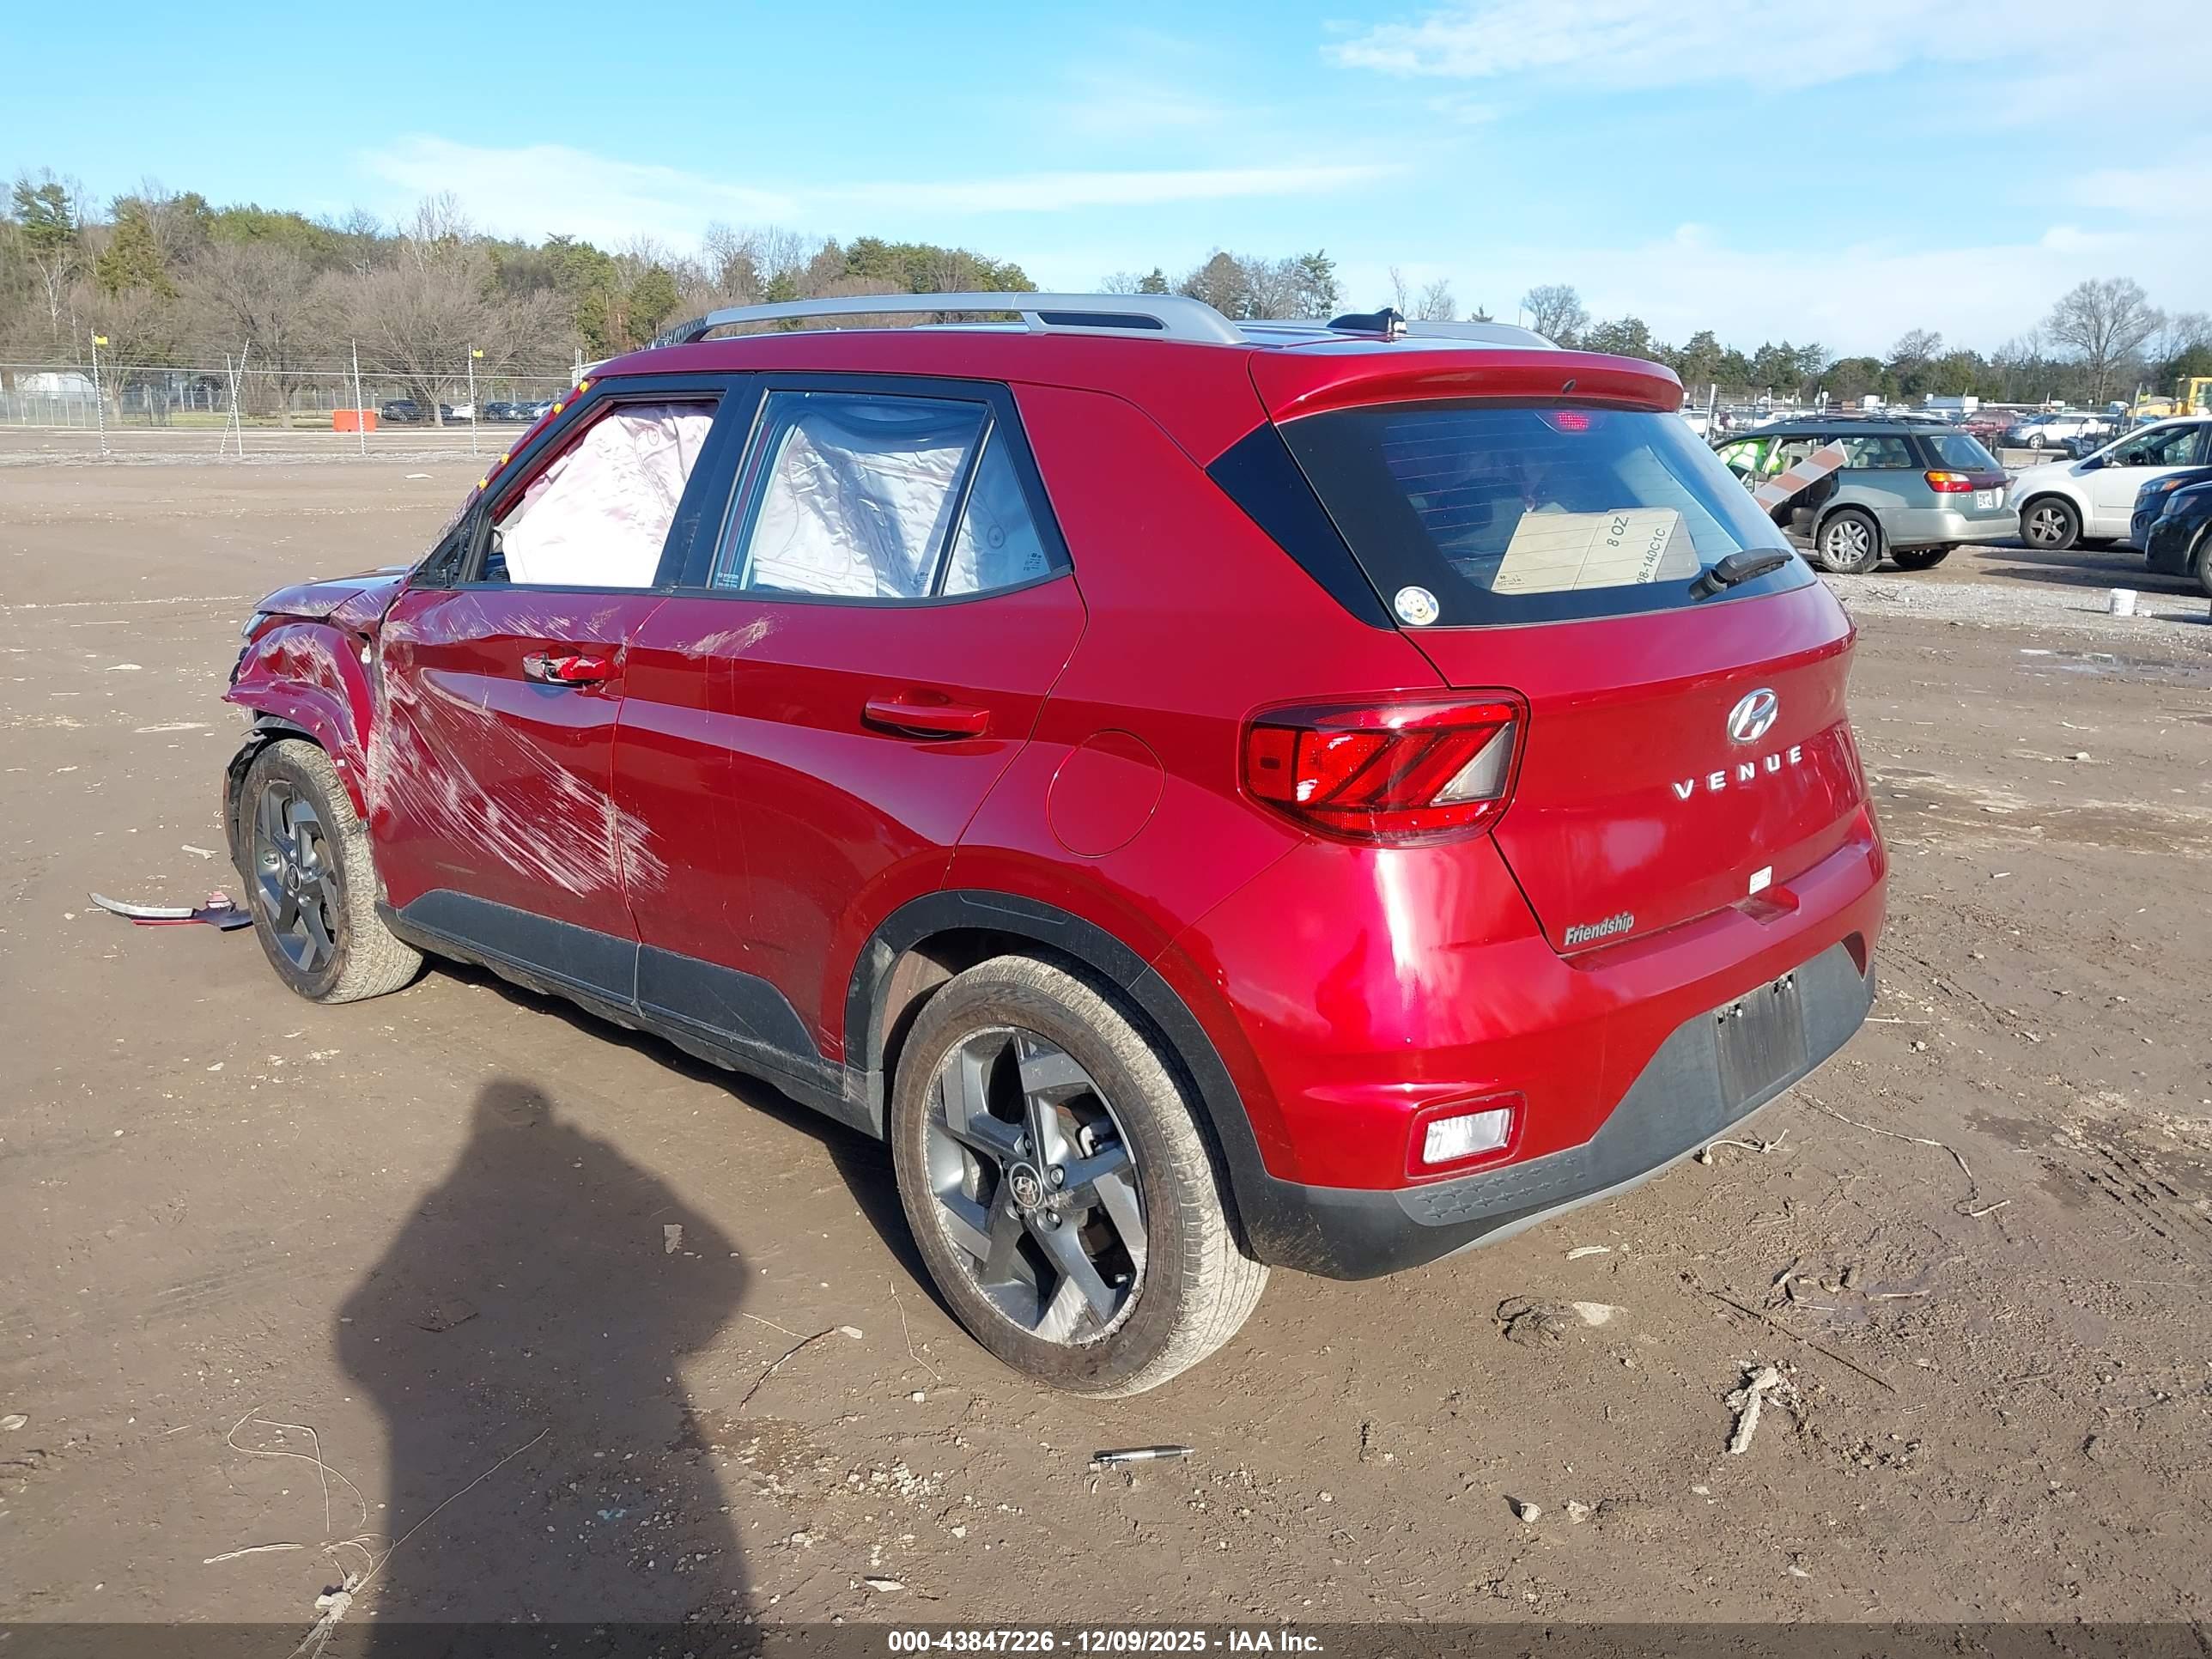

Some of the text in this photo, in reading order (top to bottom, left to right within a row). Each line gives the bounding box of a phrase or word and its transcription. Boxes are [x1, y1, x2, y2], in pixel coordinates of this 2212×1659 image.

[1607, 538, 1620, 547] 8
[1672, 745, 1802, 800] VENUE
[1565, 910, 1635, 946] Friendship
